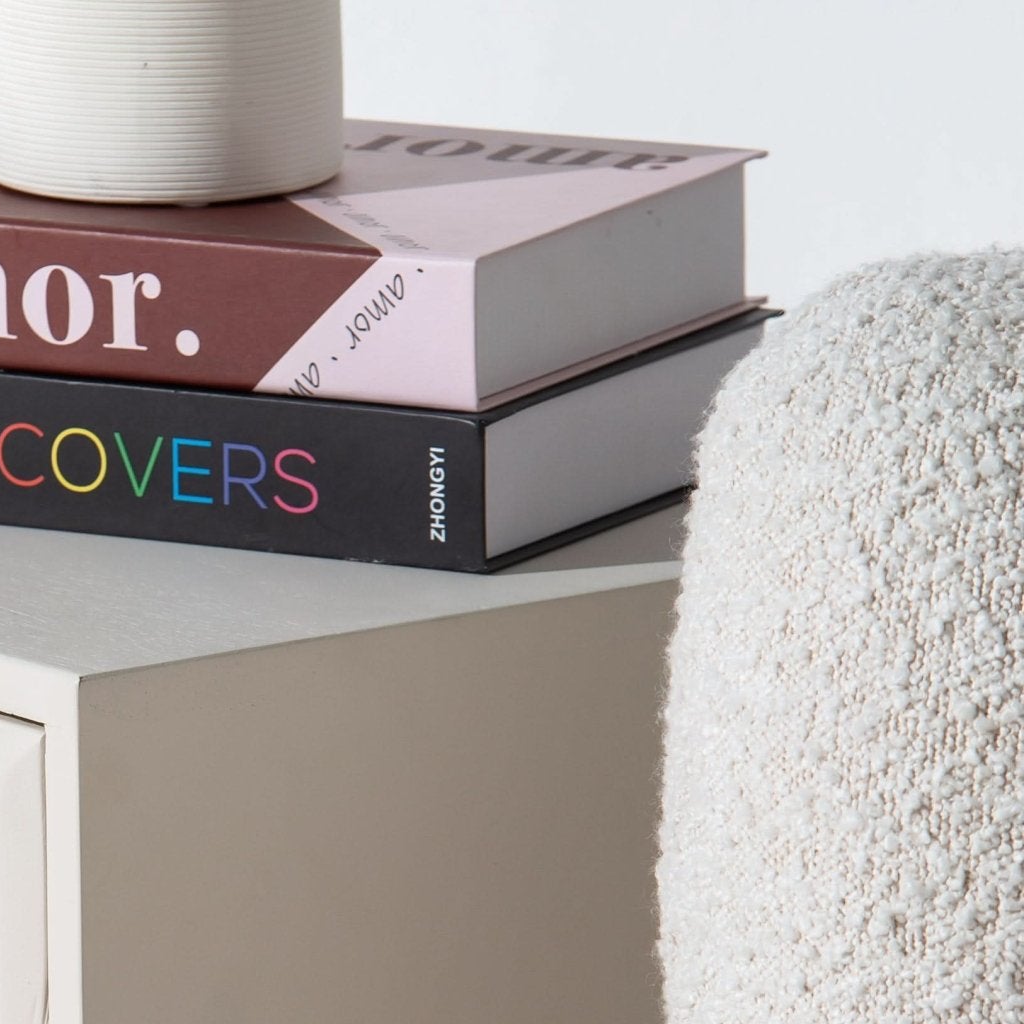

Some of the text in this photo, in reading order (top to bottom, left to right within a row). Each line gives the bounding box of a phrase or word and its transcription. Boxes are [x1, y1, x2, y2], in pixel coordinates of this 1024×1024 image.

[344, 134, 689, 170] amor
[349, 273, 404, 350] amor
[429, 446, 446, 543] ZHONGYI
